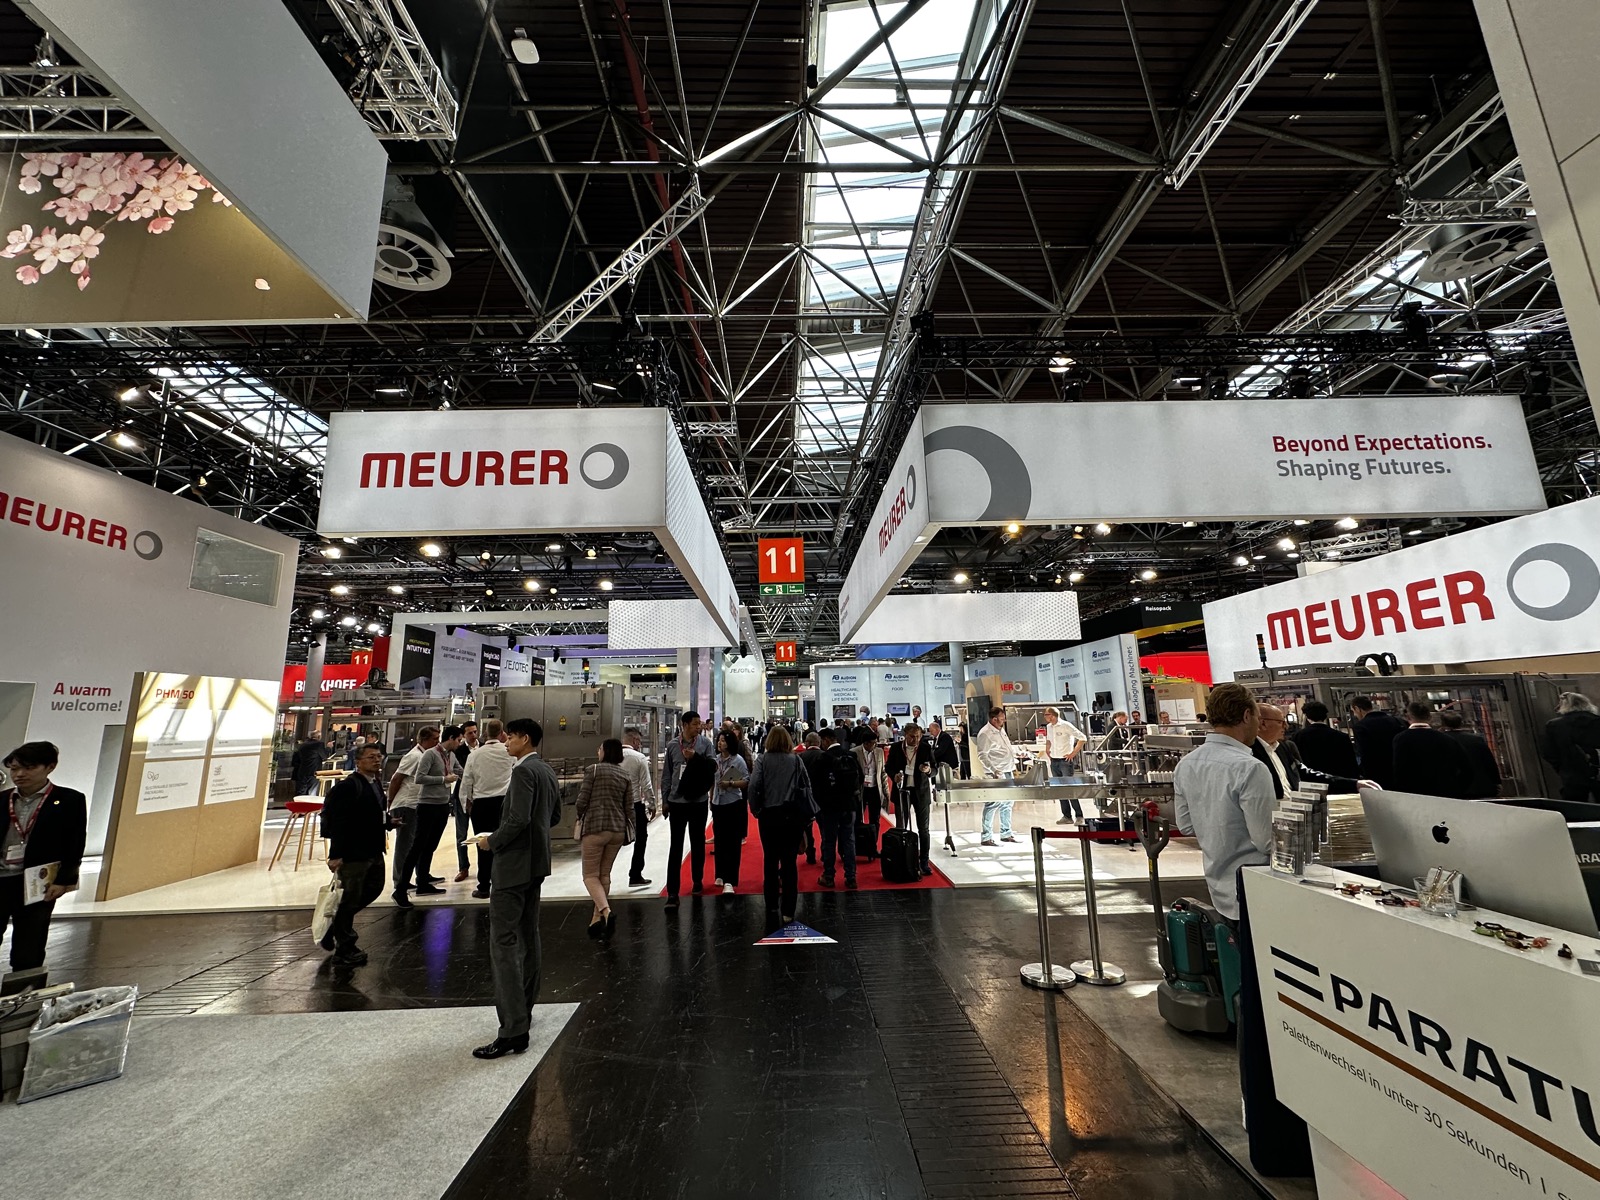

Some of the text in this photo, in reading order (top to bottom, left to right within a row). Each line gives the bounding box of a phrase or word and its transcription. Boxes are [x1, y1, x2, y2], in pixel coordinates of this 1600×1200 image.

[1272, 433, 1492, 456] Beyond Expectations.
[360, 449, 568, 488] MEURER
[1276, 458, 1451, 480] Shaping Futures.
[0, 491, 127, 550] EURER
[879, 486, 906, 557] MEURER
[765, 546, 796, 574] 11
[1266, 570, 1495, 651] MEURER
[354, 654, 369, 665] 11
[778, 645, 793, 658] 11
[53, 682, 111, 697] A warm
[155, 688, 195, 700] PHM 50
[1131, 680, 1140, 711] ackaging
[50, 698, 123, 712] welcome!
[1282, 1020, 1368, 1083] Palettenwechsel
[1369, 1073, 1380, 1092] in
[1384, 1083, 1419, 1114] unter
[1423, 1105, 1442, 1129] 30
[1446, 1120, 1530, 1185] Sekunden
